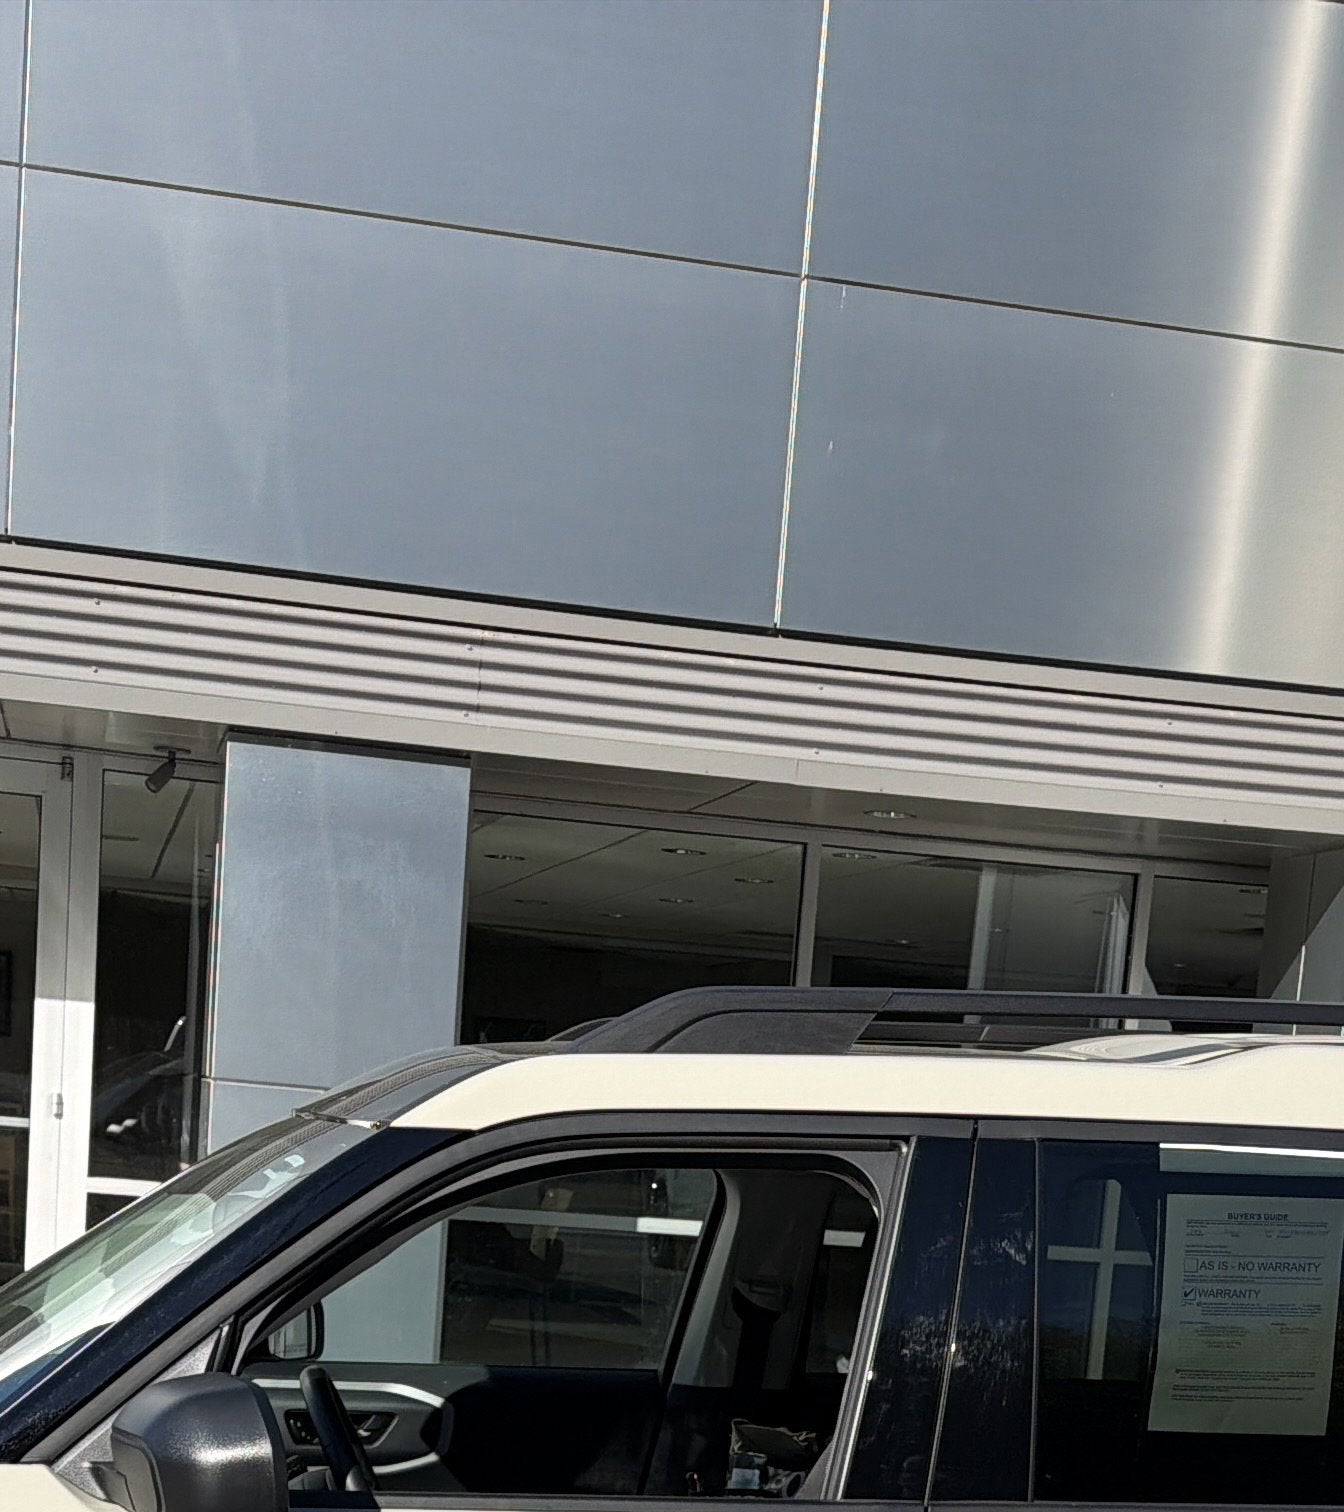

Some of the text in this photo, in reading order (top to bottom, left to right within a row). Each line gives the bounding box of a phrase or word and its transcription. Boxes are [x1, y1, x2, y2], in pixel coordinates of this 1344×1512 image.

[1227, 1212, 1289, 1222] BUYER'S GUIDE
[1199, 1260, 1215, 1271] AS
[1218, 1261, 1229, 1271] IS
[1237, 1261, 1255, 1272] NO
[1256, 1261, 1322, 1273] WARRANTY
[1197, 1288, 1262, 1299] WARRANTY
